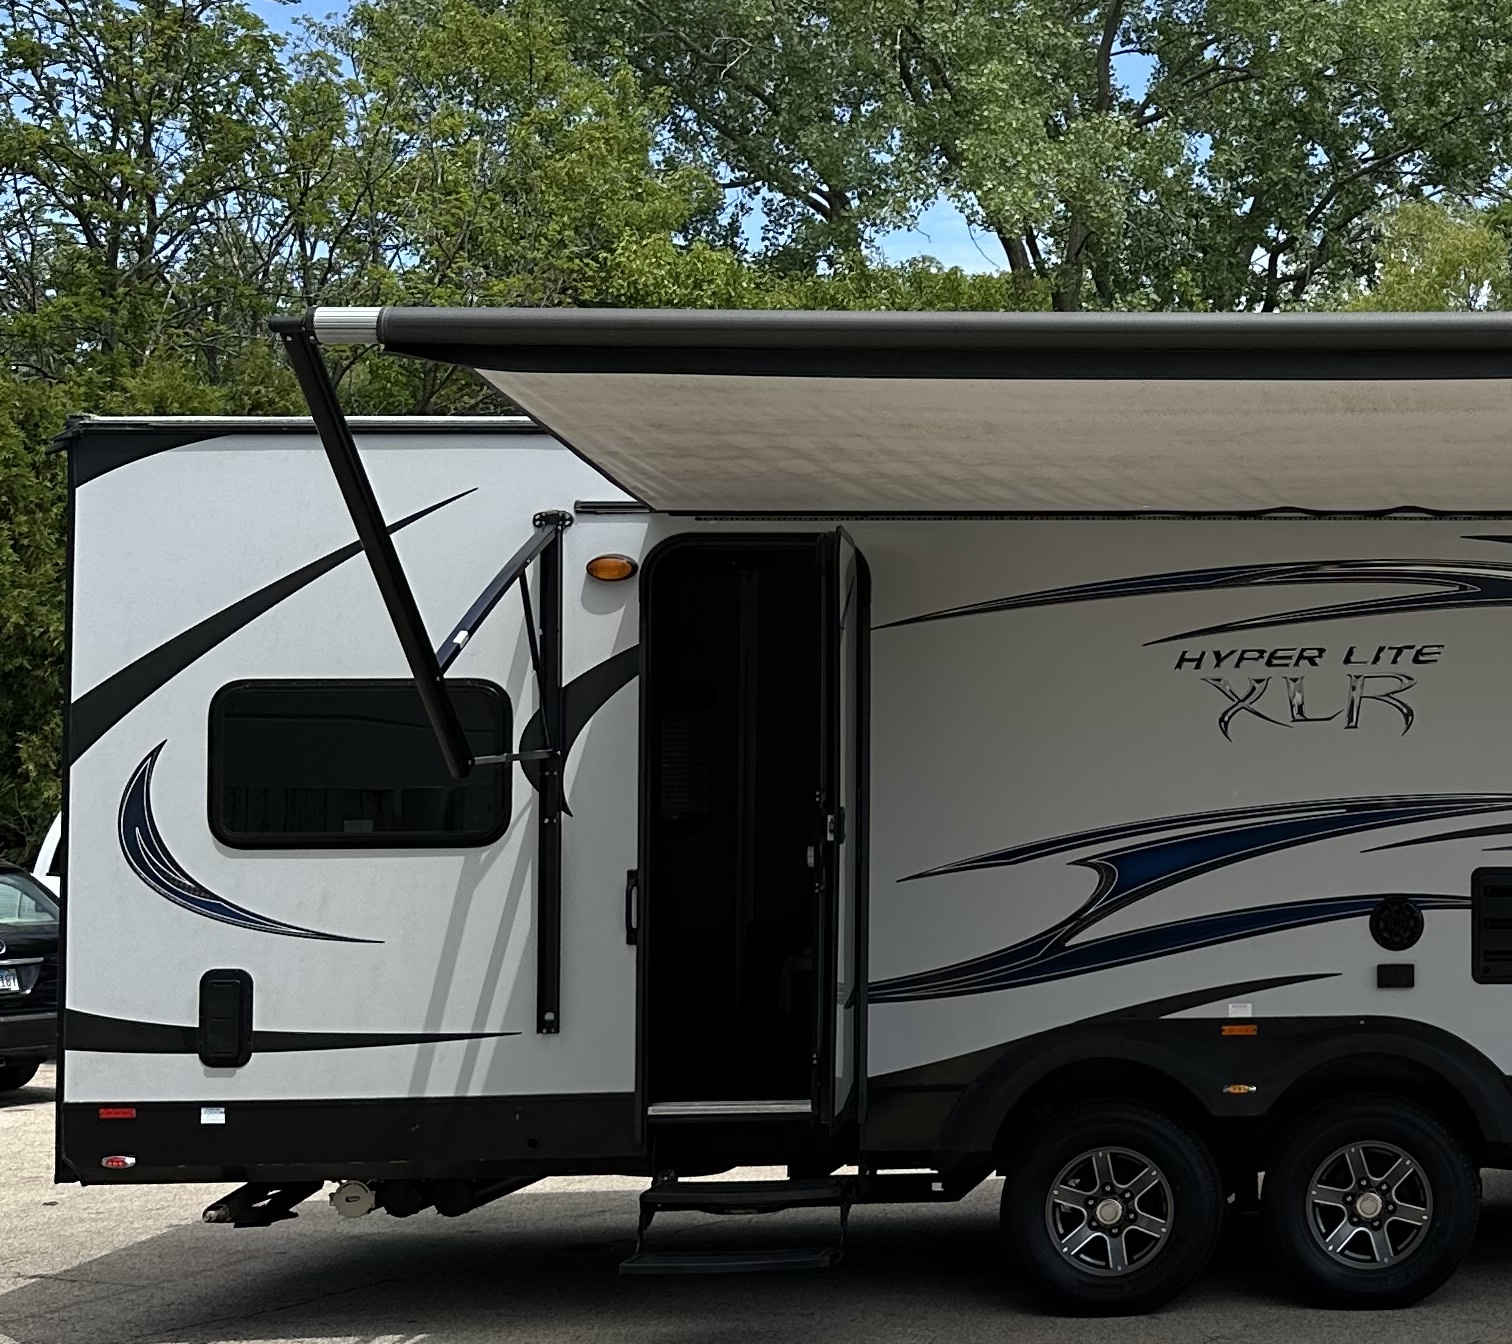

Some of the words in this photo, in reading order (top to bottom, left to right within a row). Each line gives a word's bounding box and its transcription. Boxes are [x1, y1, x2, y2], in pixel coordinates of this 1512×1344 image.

[1173, 647, 1327, 671] HYPER
[1343, 644, 1445, 666] LITE
[1200, 672, 1418, 743] XLR
